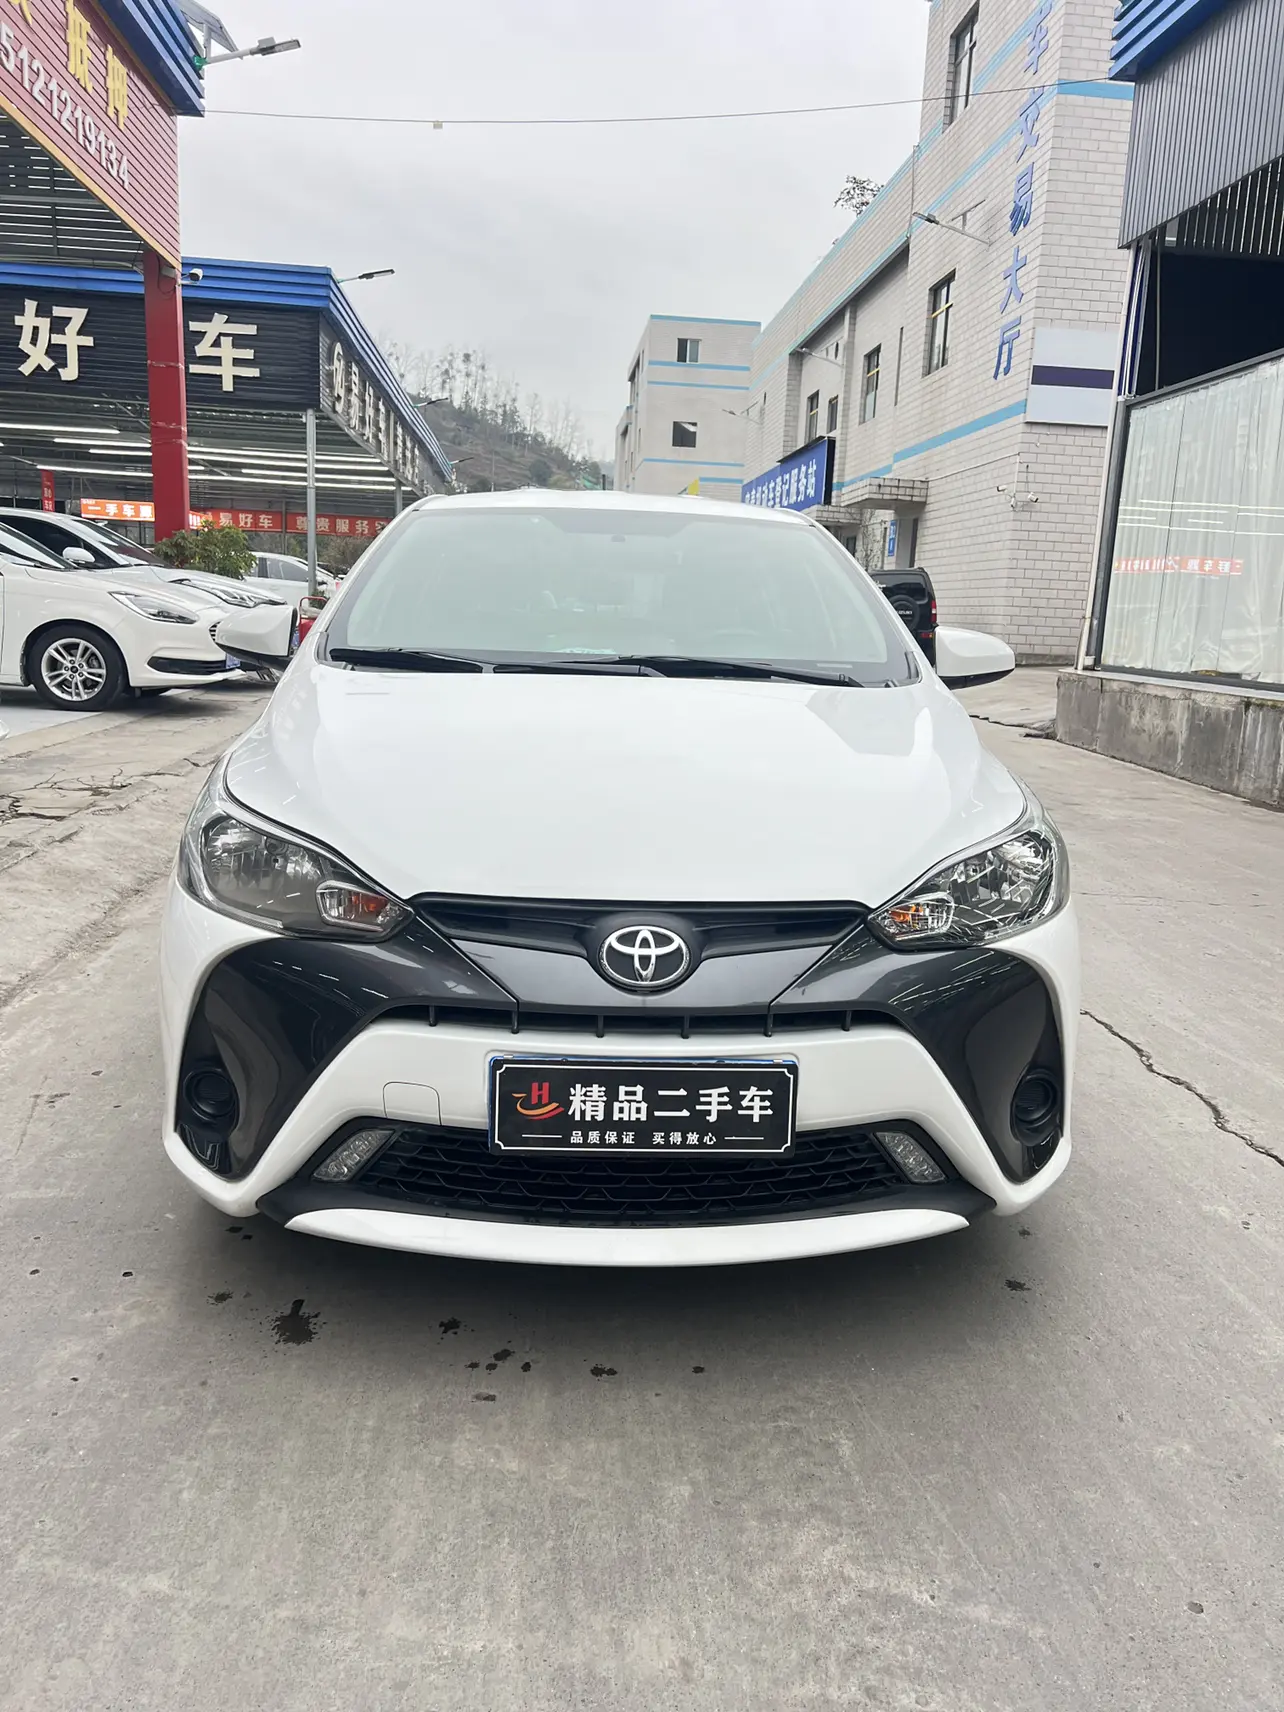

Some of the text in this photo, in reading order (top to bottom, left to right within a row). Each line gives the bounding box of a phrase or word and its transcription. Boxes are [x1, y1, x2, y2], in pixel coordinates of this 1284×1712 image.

[219, 511, 273, 529] 易好车
[567, 1083, 774, 1123] 精品二手车
[570, 1130, 717, 1145] 品质保证 买得放心
